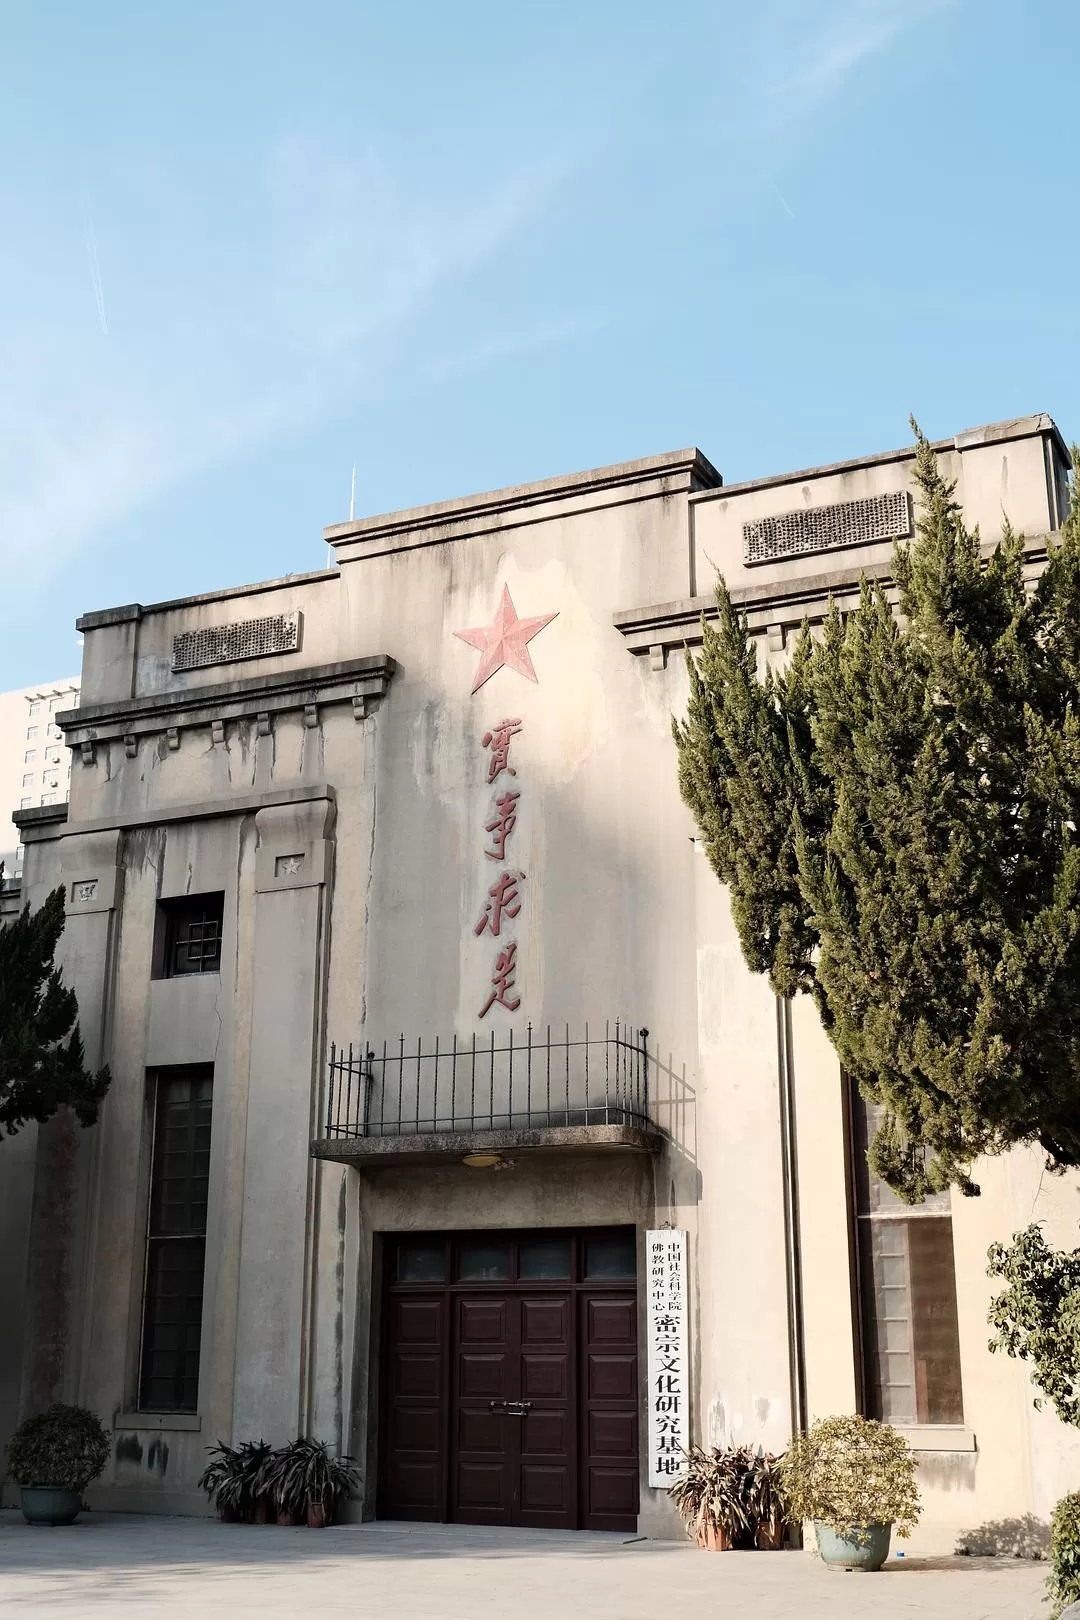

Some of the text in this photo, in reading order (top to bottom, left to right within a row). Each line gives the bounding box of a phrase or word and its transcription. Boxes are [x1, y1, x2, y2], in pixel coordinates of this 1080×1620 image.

[652, 1243, 665, 1311] 佛教研究中心
[667, 1242, 682, 1311] 中国社会科学院
[653, 1314, 682, 1475] 密宗文化研究基地
